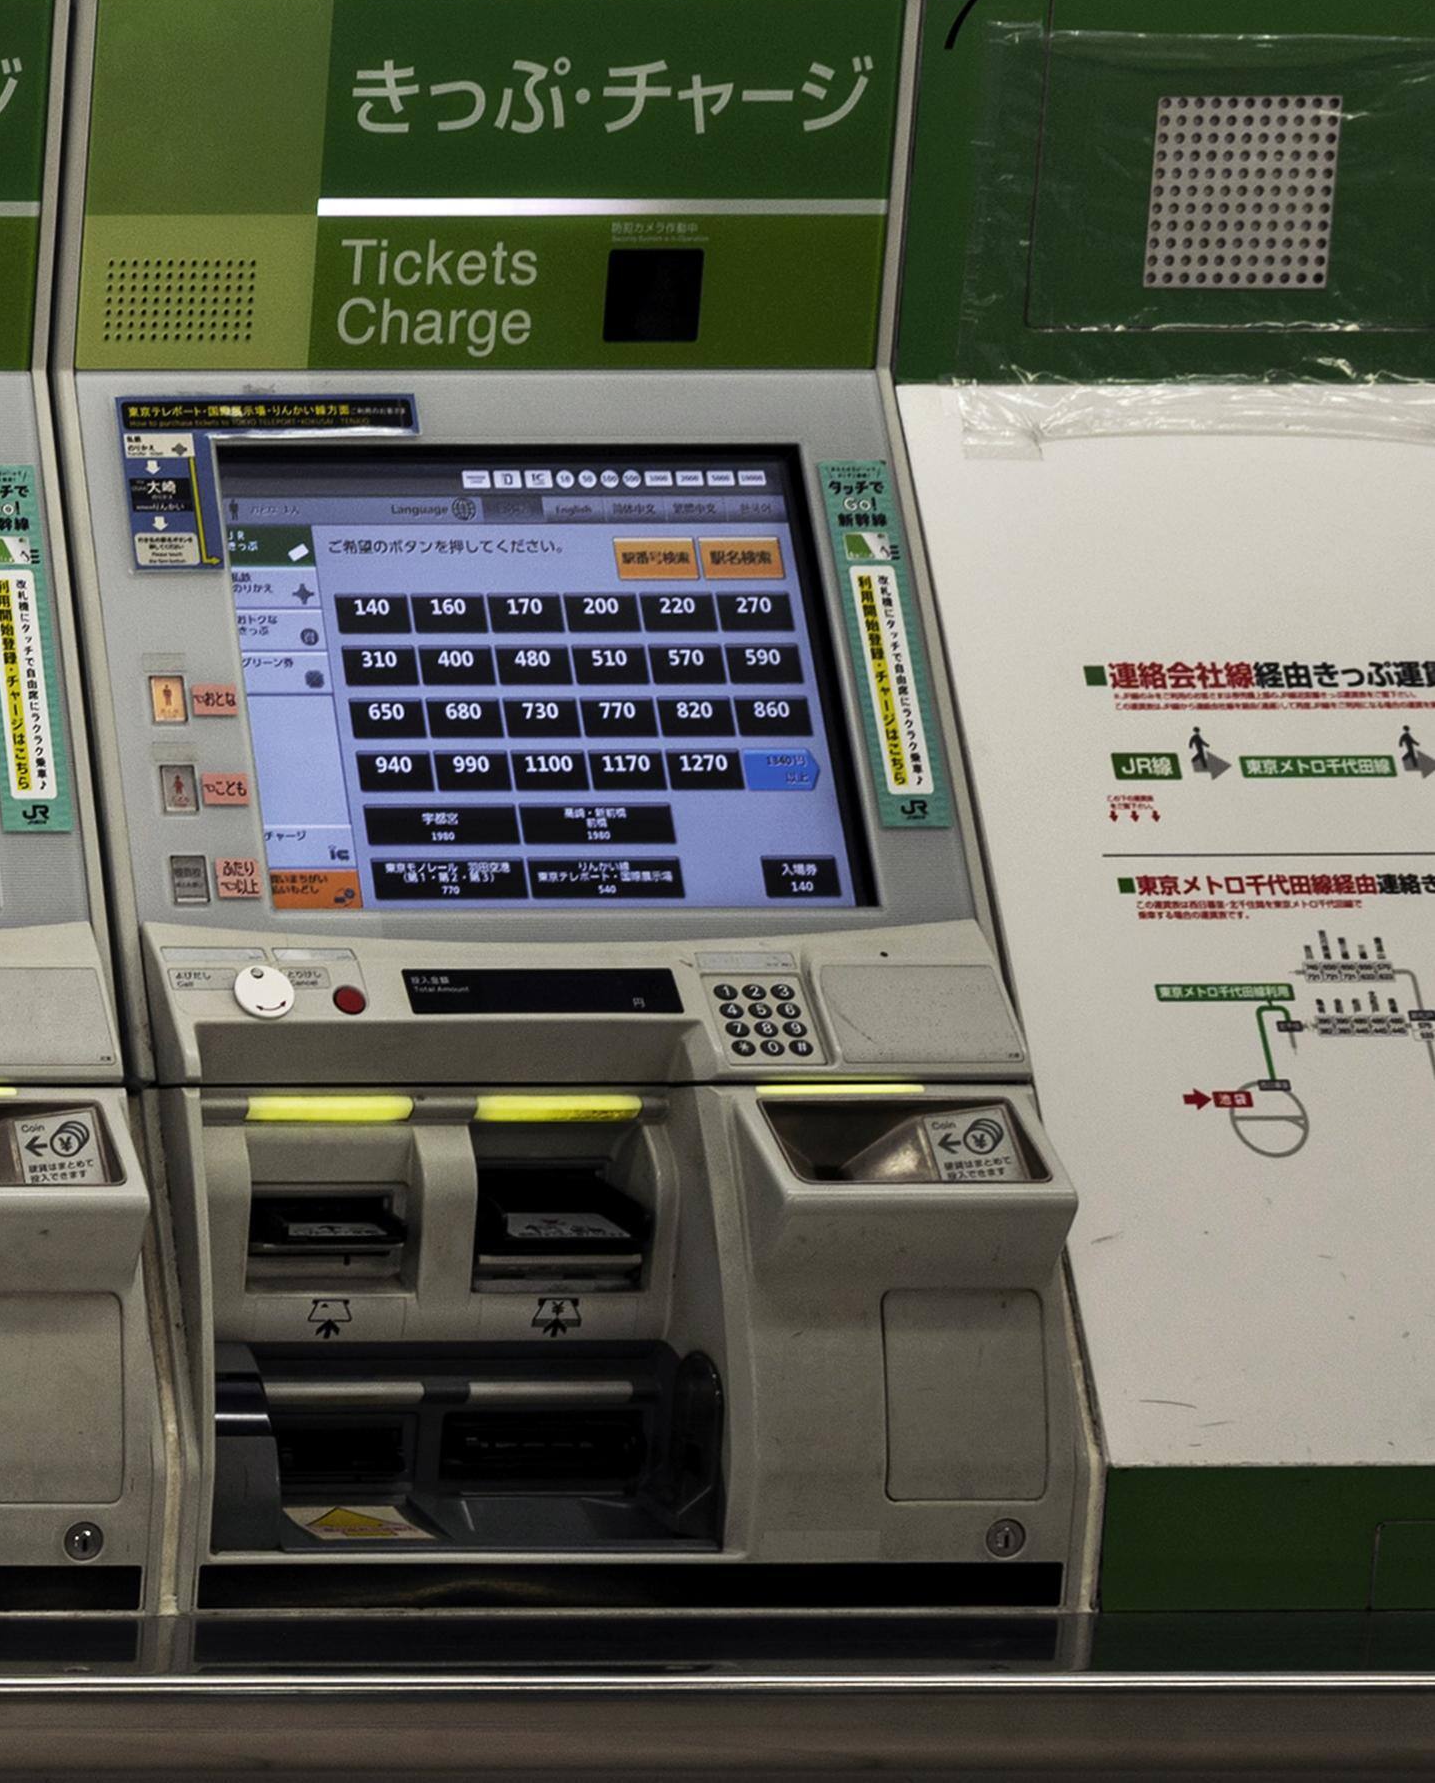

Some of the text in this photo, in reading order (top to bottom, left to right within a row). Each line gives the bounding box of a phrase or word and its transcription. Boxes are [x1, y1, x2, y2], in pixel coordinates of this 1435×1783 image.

[341, 238, 538, 286] Tickets
[337, 296, 532, 356] Charge
[659, 597, 696, 614] 220
[668, 648, 704, 666] 570
[452, 755, 490, 773] 990
[1121, 756, 1174, 777] JR線
